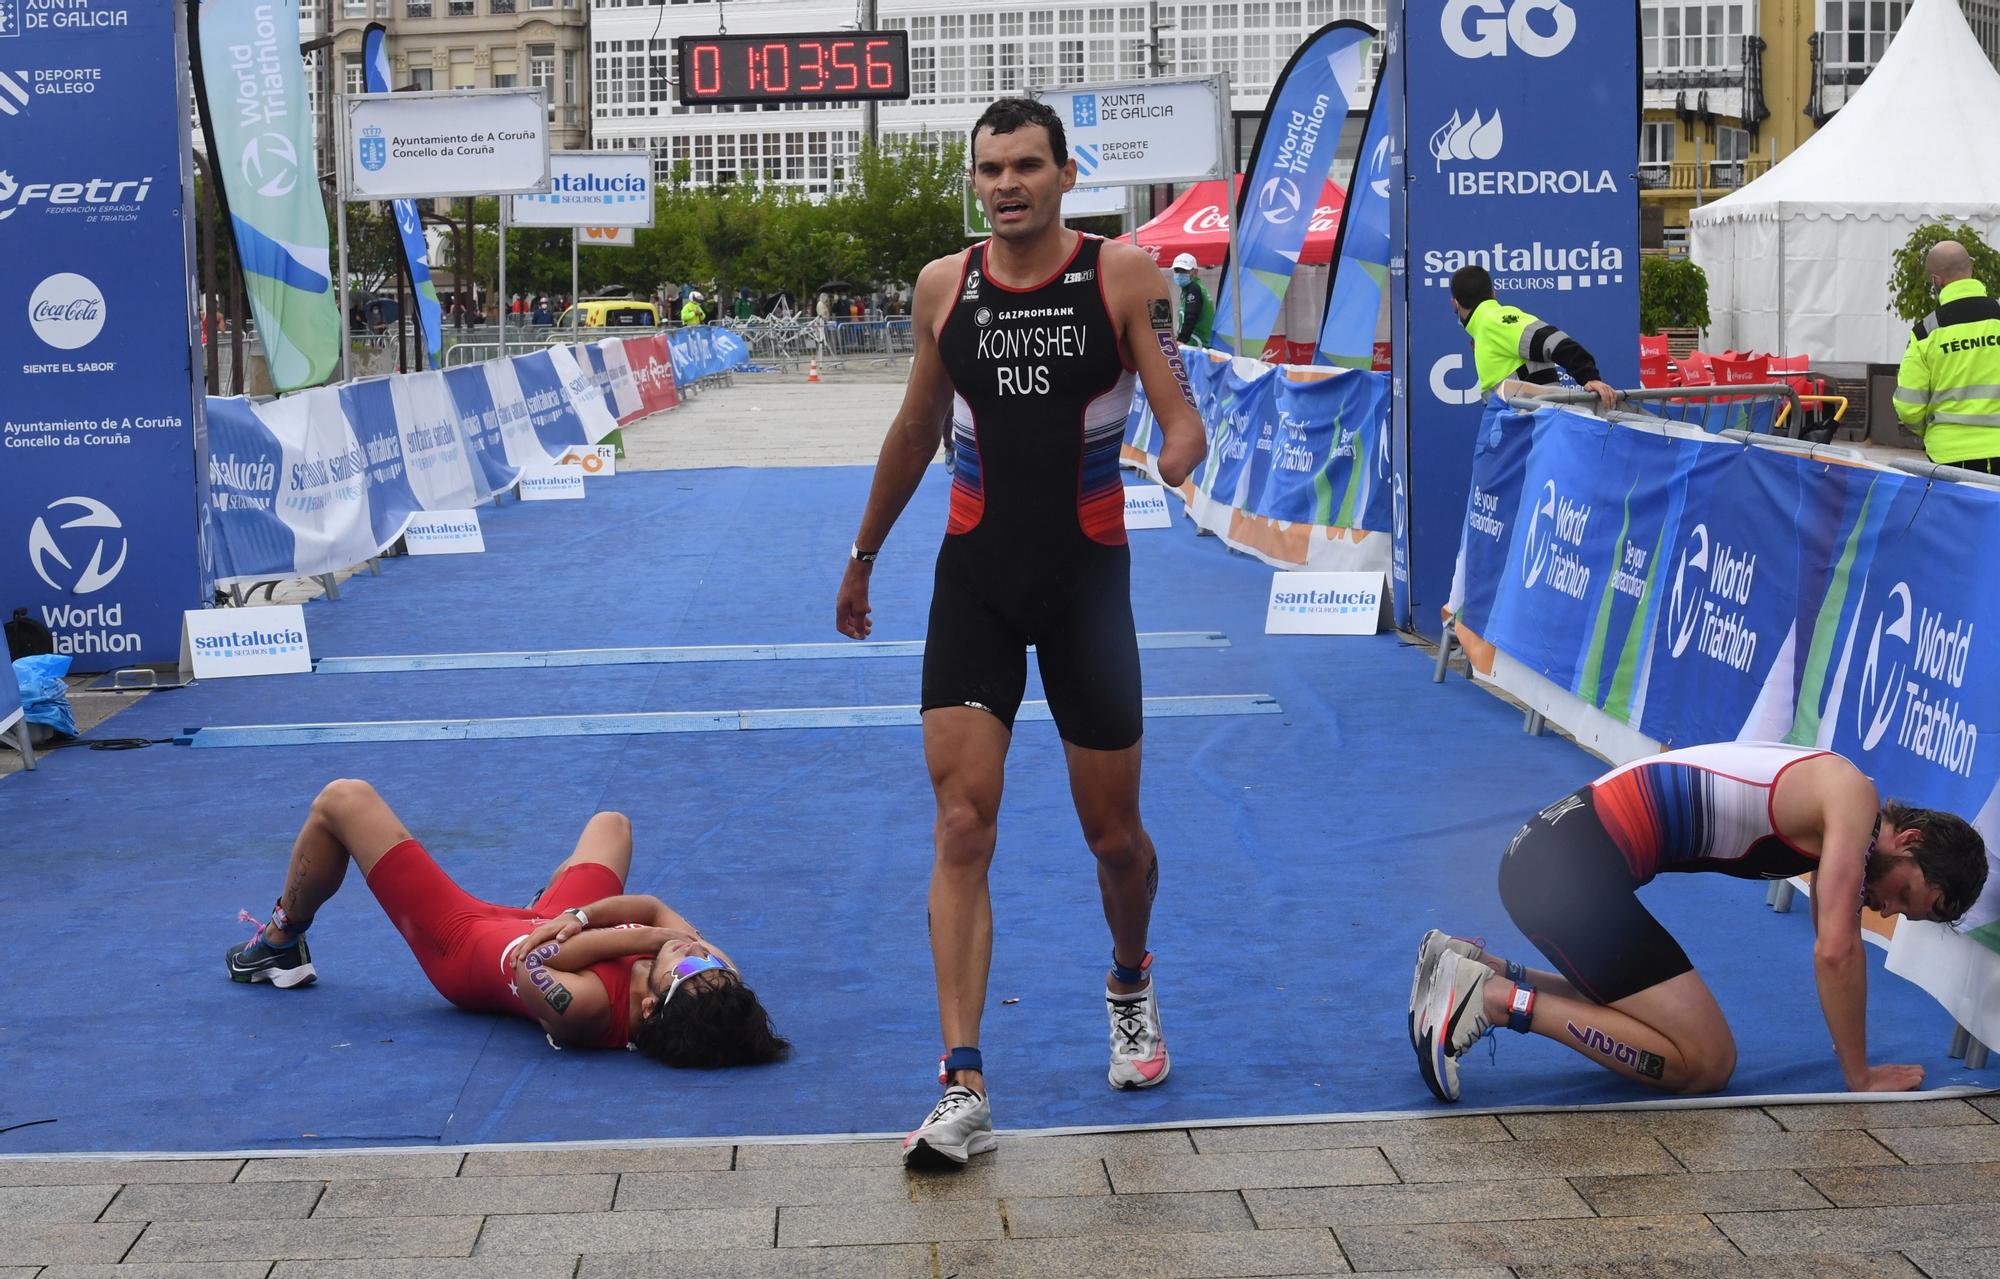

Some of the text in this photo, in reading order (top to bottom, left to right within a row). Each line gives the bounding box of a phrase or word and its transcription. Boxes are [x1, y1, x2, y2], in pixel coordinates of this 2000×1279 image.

[26, 10, 128, 28] DE GALICIA
[1440, 0, 1577, 58] GO
[34, 68, 102, 81] DEPORTE
[254, 4, 288, 125] Triathlon
[35, 82, 95, 95] GALEGO
[228, 44, 262, 128] World
[1101, 93, 1145, 107] XUNTA
[1102, 105, 1173, 120] DE GALICIA
[392, 130, 536, 148] Ayuntamiento de A Coruña
[1273, 110, 1306, 169] World
[1289, 94, 1330, 174] Triathlon
[392, 144, 495, 158] Concello da Coruña
[1102, 140, 1149, 151] DEPORTE
[1102, 151, 1145, 161] GALEGO
[550, 173, 646, 193] ntalucía
[1449, 170, 1618, 195] IBERDROLA
[46, 203, 141, 214] FEDERACIÓN ESPAÑOLA
[562, 195, 602, 204] SEGUROS
[86, 214, 138, 223] DE TRIATLÓN
[1424, 241, 1623, 274] santalucía
[1493, 277, 1554, 290] SEGUROS
[33, 298, 100, 322] Coca-Cola
[998, 307, 1075, 320] GAZPROMBANK
[977, 325, 1087, 360] KONYSHEV
[23, 364, 60, 374] SIENTE
[62, 363, 75, 373] EL
[997, 365, 1050, 396] RUS
[4, 416, 182, 436] Ayuntamiento de A Coruña
[5, 432, 131, 448] Concello da Coruña
[597, 447, 612, 458] fit
[1124, 497, 1164, 510] alucía
[1481, 493, 1499, 513] your
[1469, 508, 1505, 543] extraordinary
[1555, 496, 1591, 546] World
[1630, 548, 1647, 571] your
[1545, 543, 1591, 601] Triathlon
[1710, 542, 1756, 606] World
[1610, 567, 1648, 606] extraordinary
[1274, 590, 1377, 605] santalucía
[41, 603, 122, 628] World
[52, 630, 142, 654] iathlon
[195, 629, 303, 649] santalucía
[1698, 600, 1757, 673] Triathlon
[1914, 607, 1974, 688] World
[1897, 681, 1978, 778] Triathlon
[1566, 1020, 1640, 1069] 527
